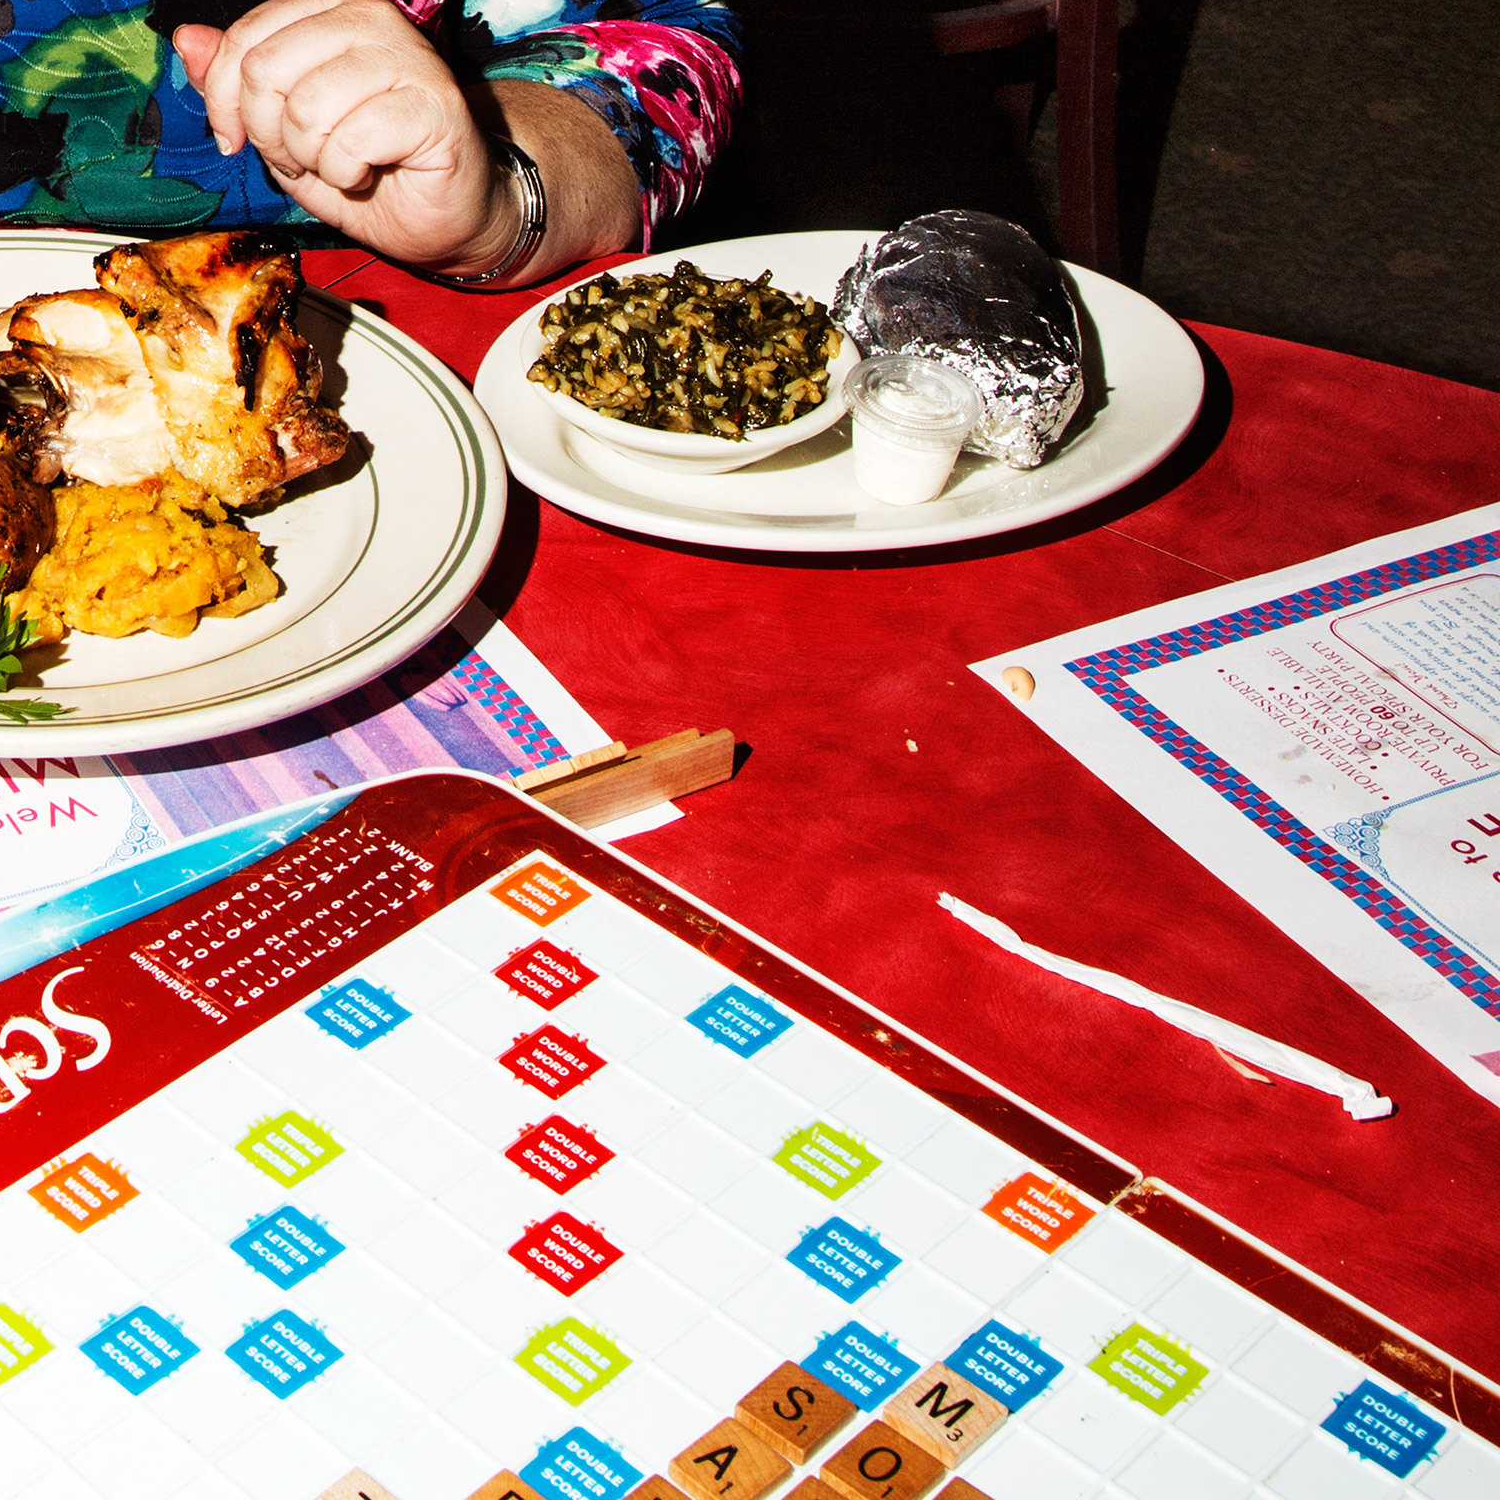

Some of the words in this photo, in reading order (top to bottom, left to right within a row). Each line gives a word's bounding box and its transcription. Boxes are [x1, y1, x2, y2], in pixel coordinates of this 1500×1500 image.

[1307, 641, 1355, 672] PARTY
[1267, 647, 1348, 703] AVAILABLE
[1315, 665, 1375, 710] PEOPLE
[1223, 674, 1296, 727] DESSERTS
[1353, 671, 1411, 717] SPECIAL
[1423, 683, 1458, 709] Thank
[1273, 692, 1333, 740] SNACKS
[1299, 691, 1382, 753] COCKTAILS
[1342, 703, 1392, 741] ROOM
[1370, 705, 1395, 720] 60
[1391, 720, 1417, 737] TO
[1408, 708, 1454, 745] YOUR
[1295, 727, 1383, 794] HOMEMADE
[1328, 734, 1371, 764] LATE
[1386, 733, 1456, 786] PRIVATE
[1413, 738, 1440, 753] UP
[1452, 743, 1489, 770] FOR
[385, 840, 434, 873] BLANK
[1450, 839, 1488, 864] to
[507, 889, 547, 917] SCORE
[522, 881, 557, 909] WORD
[532, 872, 571, 902] TRIPLE
[129, 951, 194, 1000] Distribution
[512, 970, 553, 998] SCORE
[527, 962, 563, 988] WORD
[533, 951, 581, 983] DOUBLE
[192, 998, 228, 1024] Letter
[323, 1009, 363, 1037] SCORE
[336, 999, 377, 1029] LETTER
[347, 989, 393, 1022] DOUBLE
[717, 1007, 760, 1037] LETTER
[726, 997, 775, 1029] DOUBLE
[706, 1017, 748, 1045] SCORE
[516, 1057, 559, 1087] SCORE
[532, 1049, 569, 1076] WORD
[539, 1037, 588, 1071] DOUBLE
[539, 1141, 577, 1169] WORD
[545, 1127, 597, 1164] DOUBLE
[801, 1144, 851, 1179] LETTER
[812, 1129, 862, 1168] TRIPLE
[78, 1165, 119, 1201] TRIPLE
[523, 1149, 566, 1181] SCORE
[789, 1154, 838, 1188] SCORE
[46, 1186, 89, 1221] SCORE
[65, 1176, 102, 1208] WORD
[1028, 1186, 1075, 1220] TRIPLE
[1002, 1208, 1051, 1240] SCORE
[1017, 1198, 1060, 1228] WORD
[264, 1230, 308, 1265] LETTER
[276, 1218, 326, 1256] DOUBLE
[544, 1238, 584, 1269] WORD
[551, 1225, 605, 1264] DOUBLE
[828, 1230, 883, 1269] DOUBLE
[250, 1241, 293, 1275] SCORE
[527, 1248, 573, 1282] SCORE
[807, 1254, 853, 1288] SCORE
[818, 1243, 867, 1278] LETTER
[117, 1330, 162, 1370] LETTER
[130, 1317, 181, 1360] DOUBLE
[260, 1335, 306, 1372] LETTER
[273, 1322, 325, 1363] DOUBLE
[563, 1330, 612, 1370] TRIPLE
[845, 1336, 902, 1376] DOUBLE
[987, 1333, 1045, 1375] DOUBLE
[102, 1343, 146, 1380] SCORE
[246, 1347, 291, 1383] SCORE
[532, 1353, 583, 1393] SCORE
[546, 1341, 598, 1383] LETTER
[836, 1349, 885, 1385] LETTER
[977, 1347, 1029, 1384] LETTER
[1121, 1349, 1177, 1389] LETTER
[1136, 1338, 1188, 1377] TRIPLE
[823, 1361, 872, 1396] SCORE
[965, 1359, 1016, 1395] SCORE
[1110, 1361, 1164, 1400] SCORE
[772, 1385, 815, 1421] S
[796, 1424, 808, 1436] 1
[914, 1381, 975, 1429] M
[946, 1429, 964, 1444] 3
[1364, 1396, 1426, 1437] DOUBLE
[1346, 1423, 1398, 1459] SCORE
[1356, 1411, 1411, 1448] LETTER
[555, 1455, 605, 1496] LETTER
[566, 1441, 624, 1487] DOUBLE
[692, 1444, 740, 1481] A
[719, 1481, 733, 1495] 1
[858, 1446, 902, 1483] O
[541, 1468, 590, 1500] SCOR
